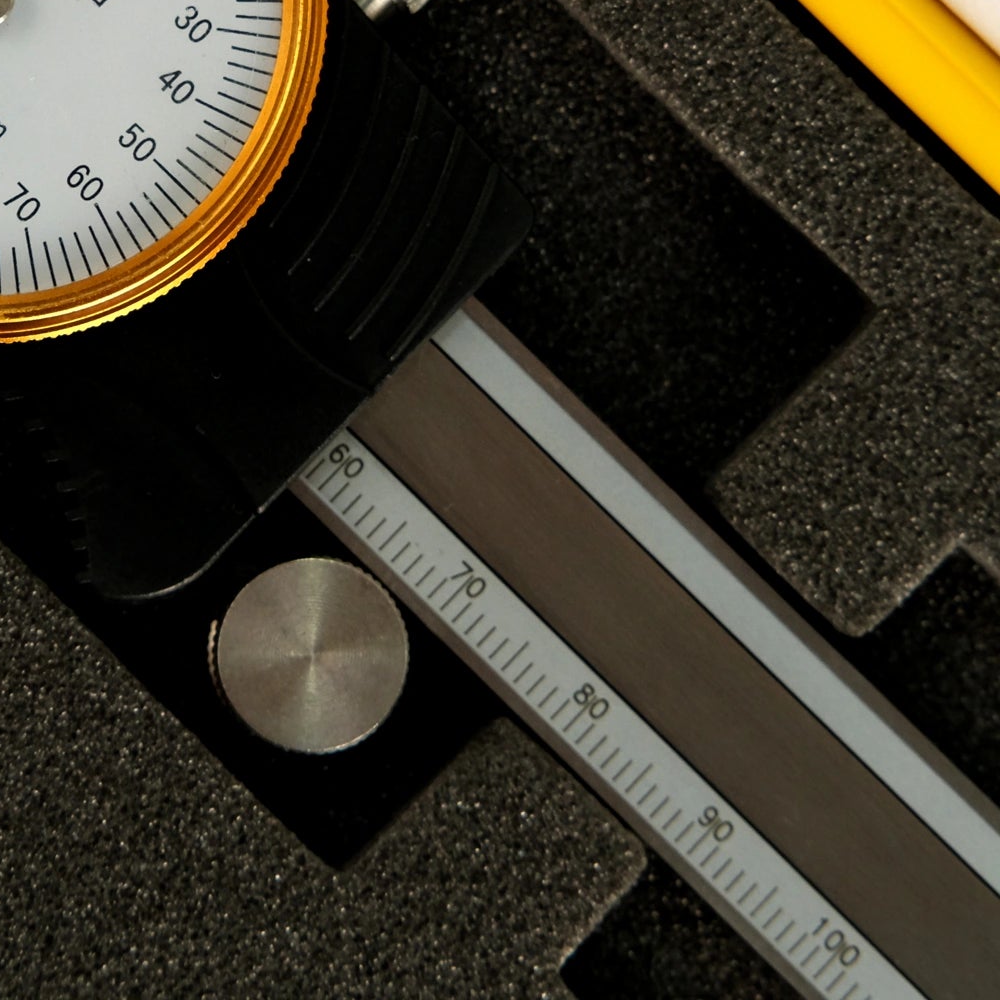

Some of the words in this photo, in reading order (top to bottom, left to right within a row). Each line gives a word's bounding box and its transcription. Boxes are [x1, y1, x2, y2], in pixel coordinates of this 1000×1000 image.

[174, 5, 213, 43] 30
[158, 70, 195, 105] 40
[118, 122, 157, 162] 50
[2, 181, 41, 222] 70
[66, 164, 104, 202] 60
[329, 443, 364, 479] 60
[451, 560, 486, 598] 70
[573, 682, 609, 720] 80
[697, 805, 734, 843] 90
[812, 917, 860, 967] 100
